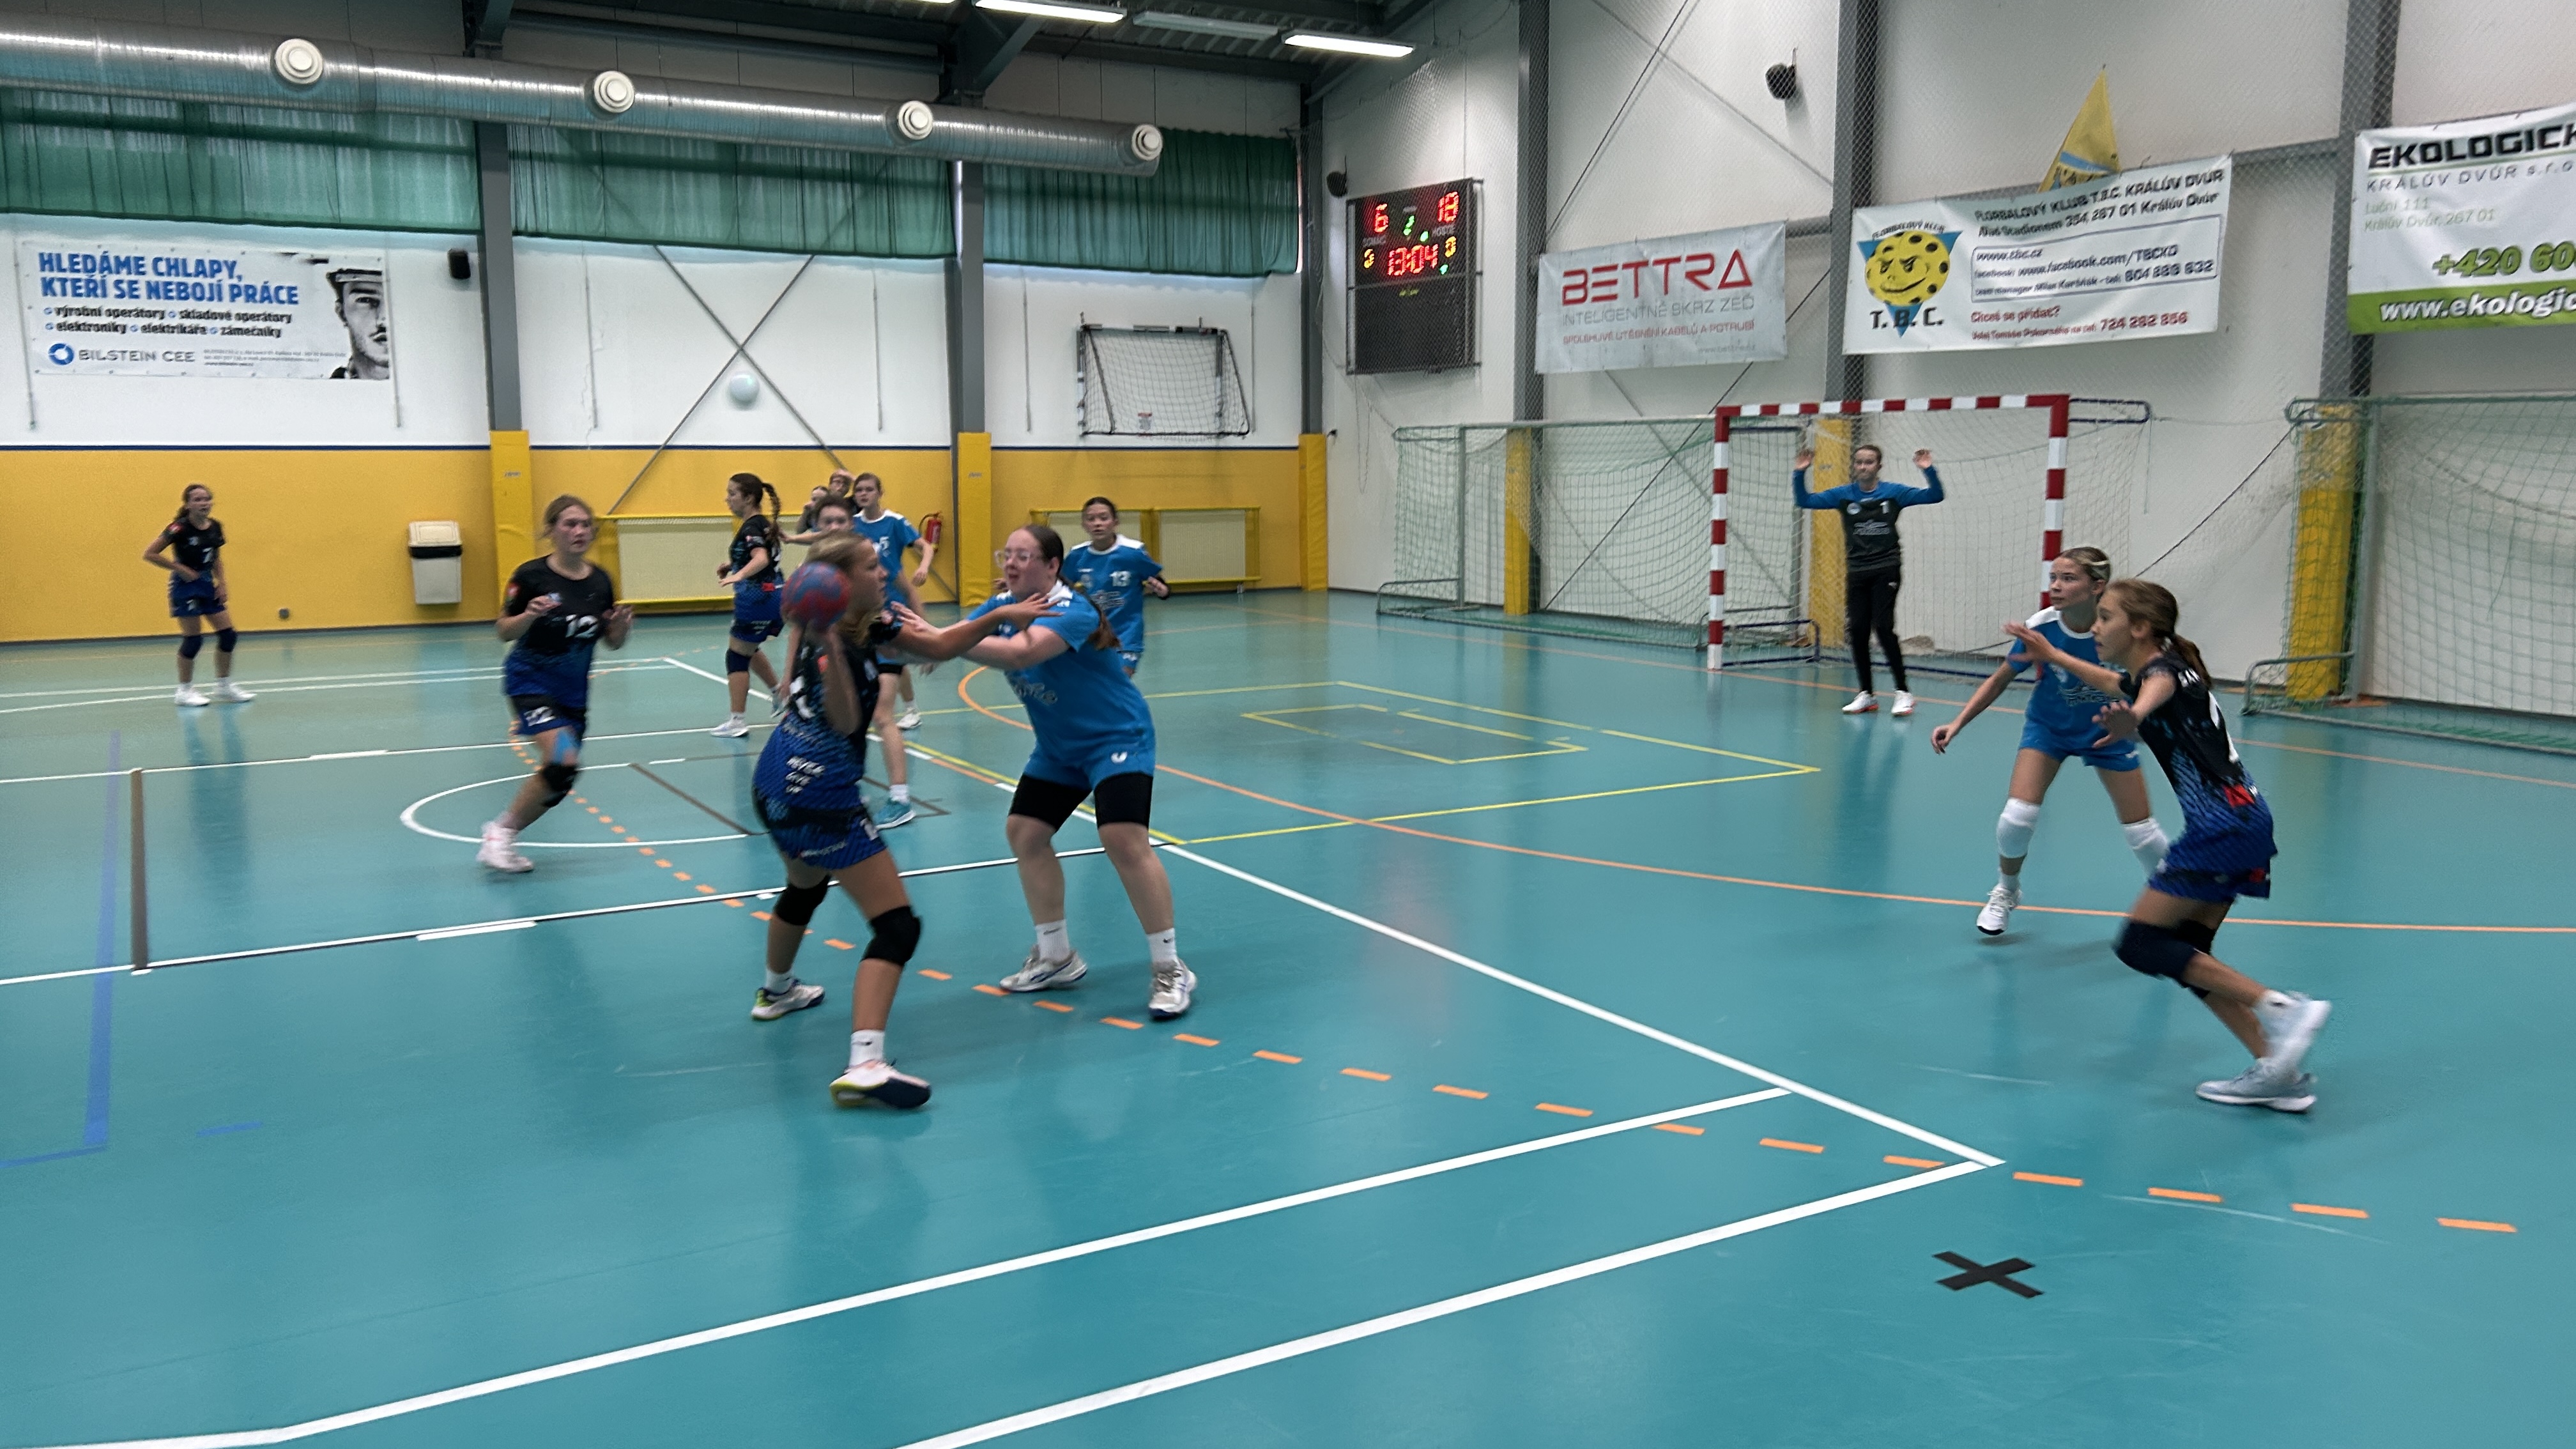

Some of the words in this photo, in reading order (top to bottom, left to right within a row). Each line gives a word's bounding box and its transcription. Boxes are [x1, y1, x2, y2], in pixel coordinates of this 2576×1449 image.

[2368, 122, 2576, 170] EKOLOGICK
[2050, 194, 2089, 213] KLUB
[2119, 202, 2137, 217] 01
[1373, 203, 1390, 234] 6
[2477, 208, 2496, 222] 01
[38, 250, 146, 276] HLEDÁME
[151, 256, 243, 282] CHLAPY,
[2432, 245, 2522, 278] +420
[2529, 240, 2576, 273] 60
[1562, 248, 1752, 306] BETTRA
[40, 274, 108, 298] KTEŘÍ
[112, 279, 141, 300] SE
[145, 279, 224, 302] NEBOJÍ
[227, 280, 299, 305] PRÁCE
[104, 306, 166, 320] operátory
[234, 311, 293, 324] operátory
[1671, 298, 1715, 316] SKRZ
[56, 320, 128, 335] elektroniky
[1700, 324, 1707, 334] A
[78, 349, 157, 362] BILSTEIN
[162, 350, 195, 363] CEE
[1879, 500, 1889, 514] 1
